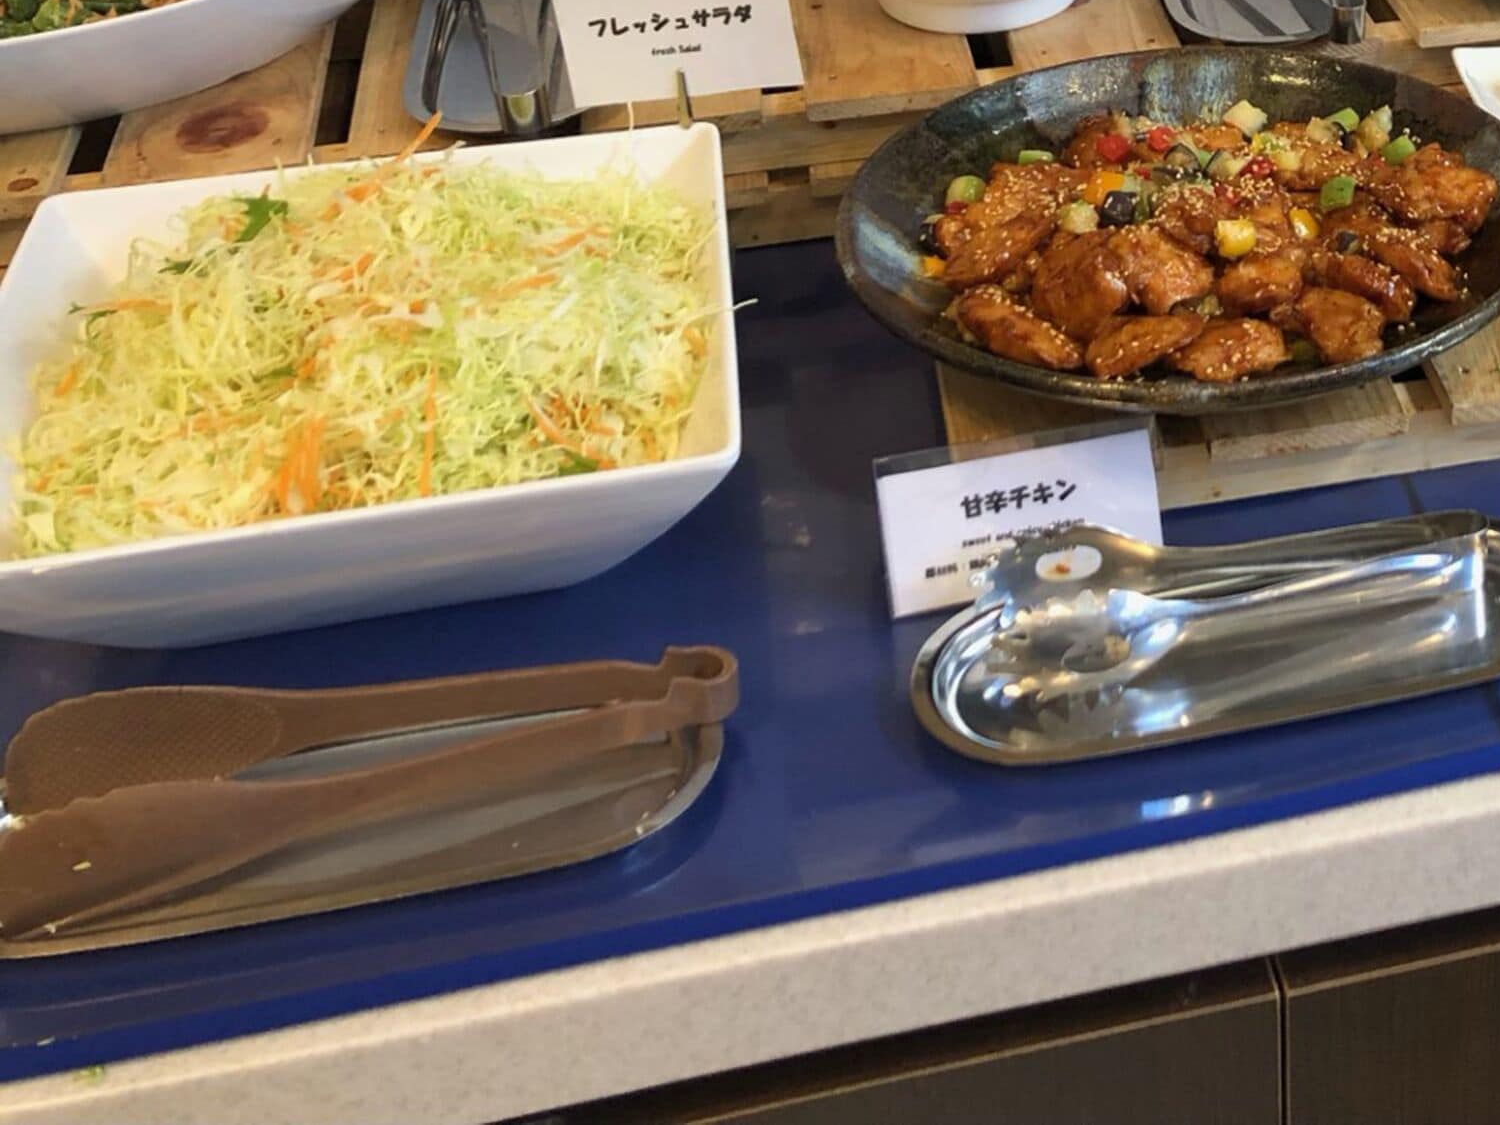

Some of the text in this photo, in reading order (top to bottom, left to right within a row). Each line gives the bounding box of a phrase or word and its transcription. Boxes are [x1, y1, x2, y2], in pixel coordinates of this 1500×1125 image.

[588, 4, 752, 37] フレッシュサラダ
[960, 479, 1077, 519] 甘辛チキン
[962, 534, 991, 548] sweet
[996, 530, 1013, 541] and
